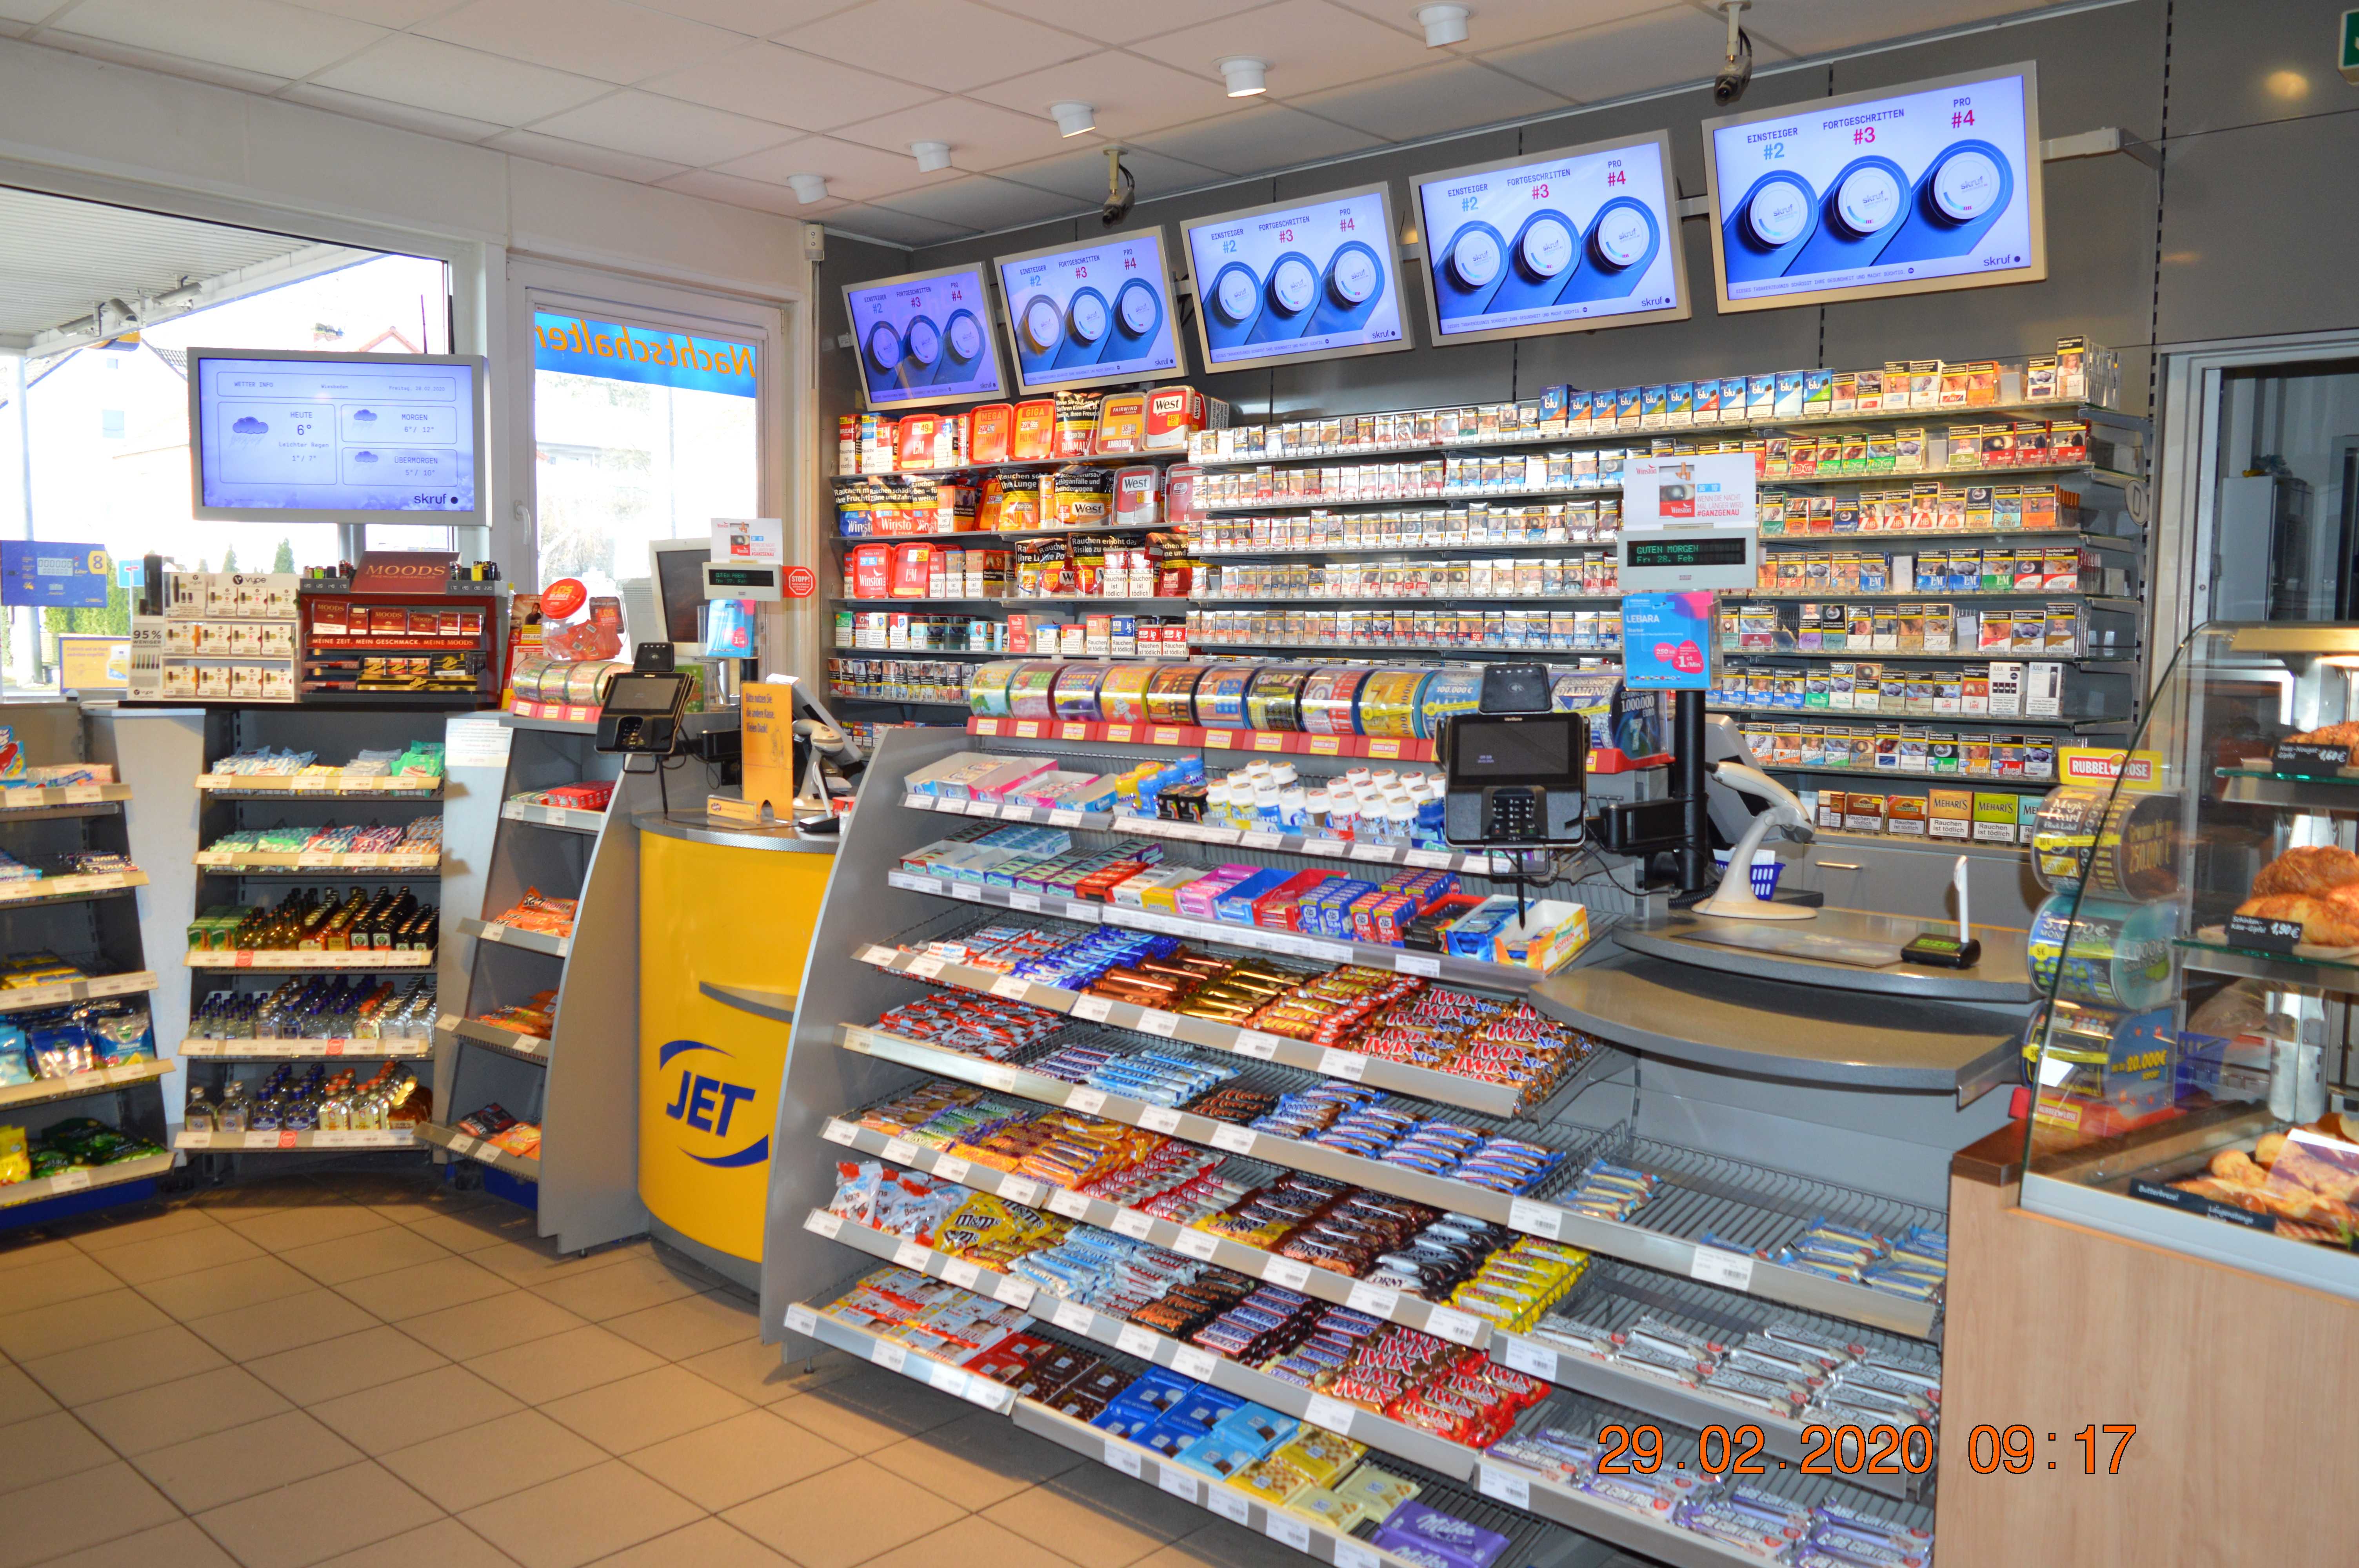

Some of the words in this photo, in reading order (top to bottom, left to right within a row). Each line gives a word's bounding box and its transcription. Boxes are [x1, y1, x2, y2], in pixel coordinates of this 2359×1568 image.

[1954, 98, 1970, 107] PRO
[1823, 109, 1905, 130] FORTGESCHRITTEN
[1952, 109, 1975, 128] #4
[1747, 127, 1798, 143] EINSTEIGER
[1854, 127, 1875, 145] #3
[1764, 142, 1785, 160] #2
[1608, 160, 1622, 169] PRO
[1507, 169, 1570, 187] FORTGESCHRITTEN
[1608, 171, 1626, 187] #4
[1448, 183, 1488, 197] EINSTEIGER
[1532, 184, 1549, 200] #3
[1462, 197, 1479, 211] #2
[1259, 216, 1310, 231] FORTGESCHRITTEN
[1340, 218, 1354, 232] #4
[1211, 229, 1244, 240] EINSTEIGER
[1279, 229, 1293, 243] #3
[1223, 240, 1237, 253] #2
[1058, 255, 1100, 267] FORTGESCHRITTEN
[1125, 257, 1137, 270] #4
[1983, 255, 2010, 267] skruf
[1020, 265, 1046, 275] EINSTEIGER
[1076, 266, 1087, 279] #3
[1030, 275, 1041, 287] #2
[896, 287, 931, 298] FORTGESCHRITTEN
[952, 290, 962, 302] #4
[864, 294, 886, 303] EINSTEIGER
[911, 297, 921, 308] #3
[1641, 296, 1662, 307] skruf
[873, 303, 883, 314] #2
[1372, 330, 1389, 339] skruf
[1155, 358, 1169, 367] skruf
[1156, 400, 1179, 410] West
[1544, 400, 1557, 409] blu
[1573, 401, 1583, 410] blu
[1596, 400, 1607, 409] blu
[981, 411, 1002, 420] MEGA
[1027, 407, 1045, 417] GIGA
[297, 424, 311, 436] 6°
[1107, 440, 1120, 449] JUMBO
[1121, 439, 1132, 448] BOX
[1125, 479, 1147, 489] West
[414, 494, 446, 504] skruf
[1075, 504, 1101, 514] West
[1697, 509, 1739, 517] #GANZGENAU
[1637, 546, 1663, 554] GUTEN
[1667, 544, 1699, 553] MORGEN
[93, 555, 103, 569] 8
[366, 565, 446, 575] MOODS
[860, 574, 883, 586] Winston
[551, 585, 573, 593] LOS
[1626, 614, 1659, 623] LEBARA
[133, 630, 149, 639] 95
[1558, 686, 1610, 696] DIAMOND
[755, 694, 766, 702] nutzen
[752, 708, 763, 718] andere
[1643, 709, 1654, 717] EURO
[747, 722, 756, 732] Vielen
[1970, 760, 1988, 773] ducal
[2003, 762, 2022, 775] ducal
[2072, 760, 2109, 775] RUBBEL
[2126, 765, 2148, 777] OSE
[1934, 797, 1968, 810] MEHARI'S
[1978, 802, 2013, 814] MEHARI'S
[666, 1070, 756, 1138] JET
[904, 1206, 926, 1216] Bons
[1416, 1513, 1477, 1538] Milka
